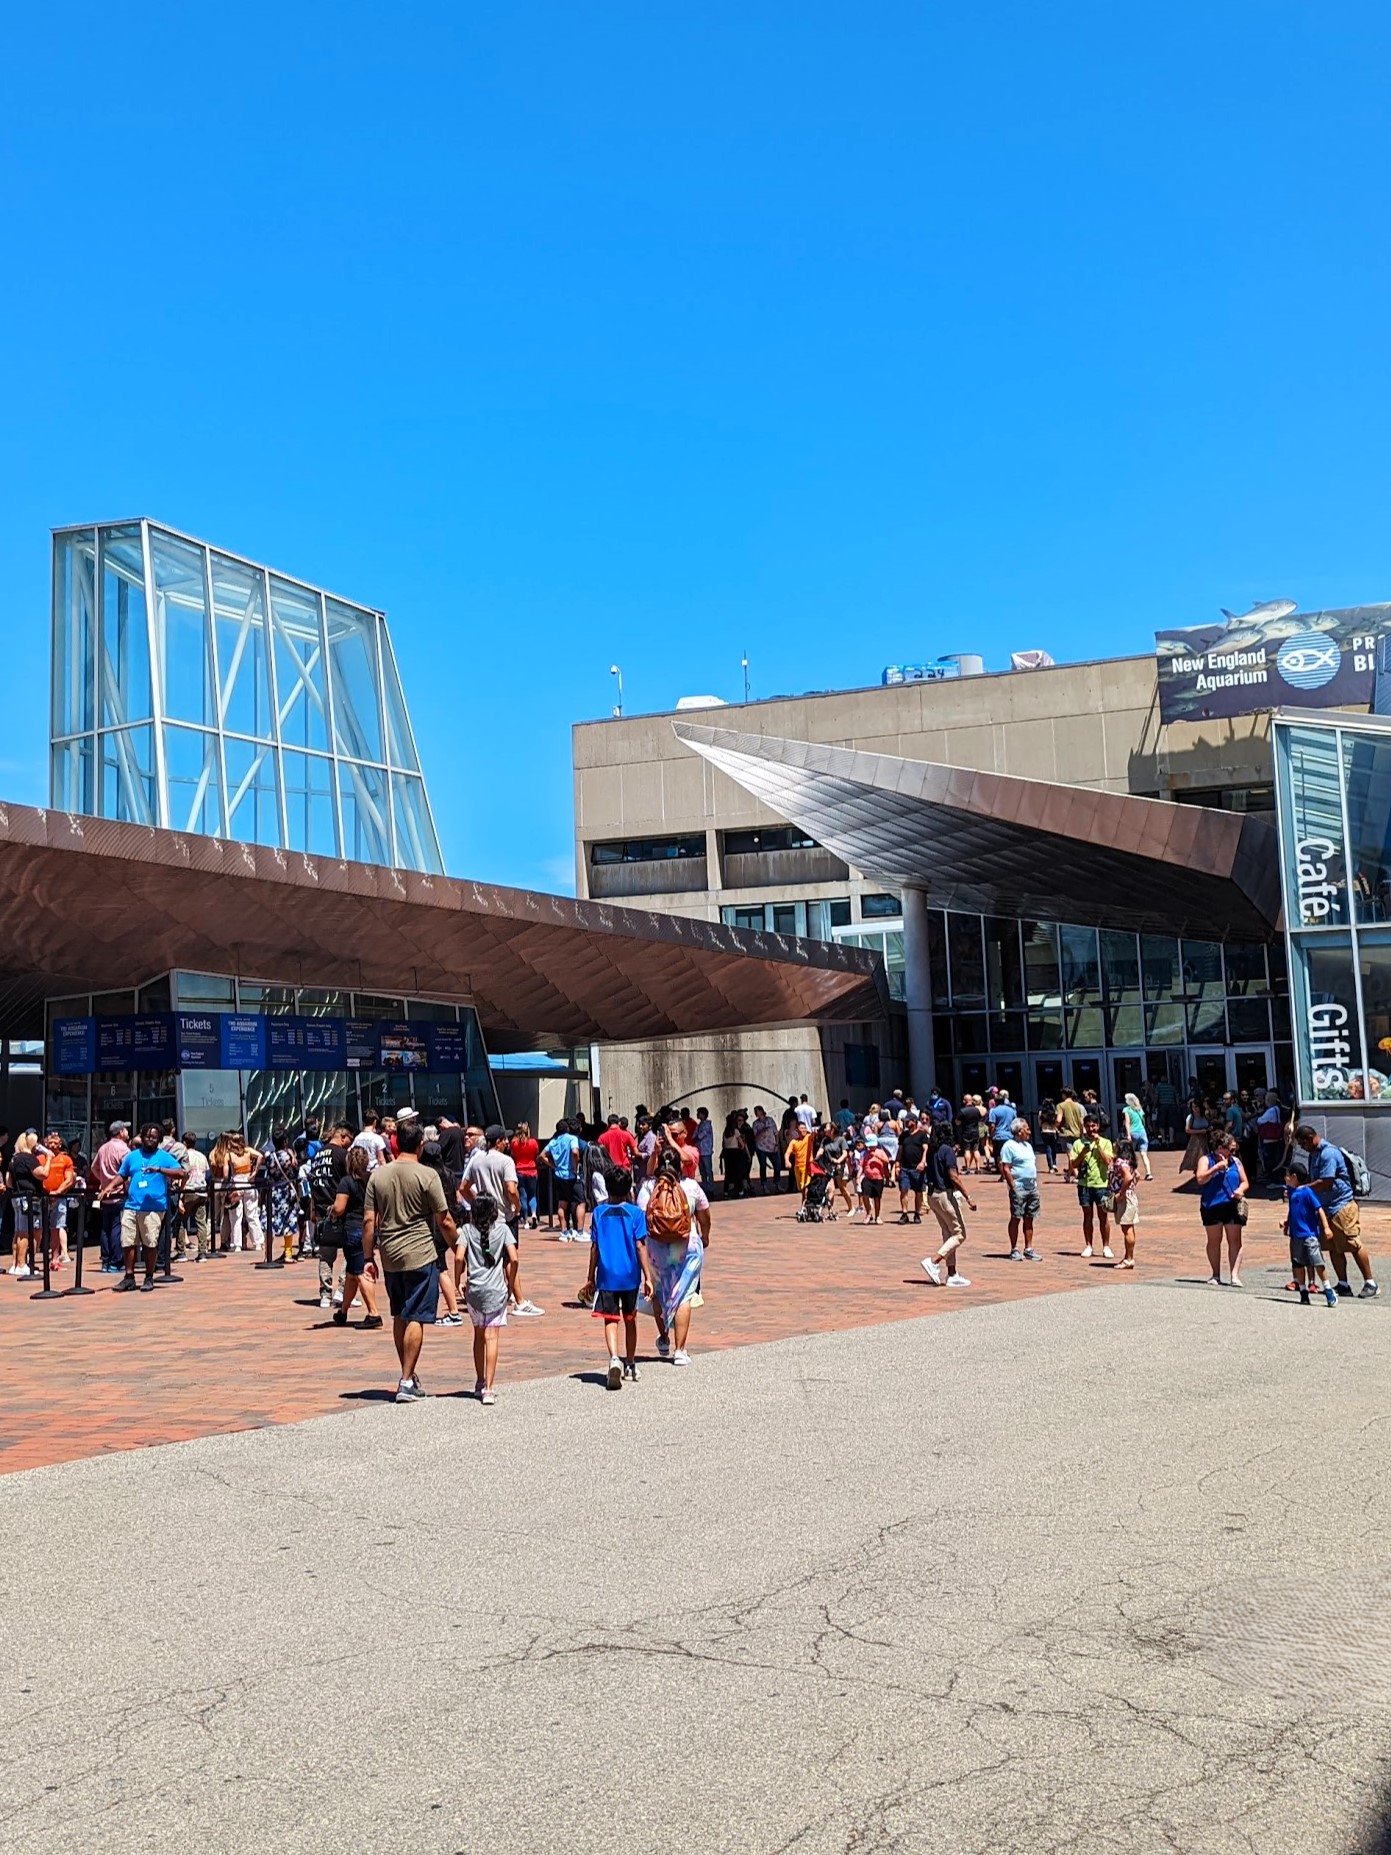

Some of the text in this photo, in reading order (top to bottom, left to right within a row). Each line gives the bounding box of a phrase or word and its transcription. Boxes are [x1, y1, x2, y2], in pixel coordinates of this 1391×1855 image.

[1172, 648, 1266, 673] New England
[1196, 670, 1268, 691] Aquarium
[1295, 837, 1341, 918] Café
[180, 1018, 211, 1030] Tickets
[1307, 1003, 1350, 1090] Gifts
[110, 1086, 116, 1096] 6
[382, 1084, 388, 1093] 2
[436, 1084, 440, 1093] 1
